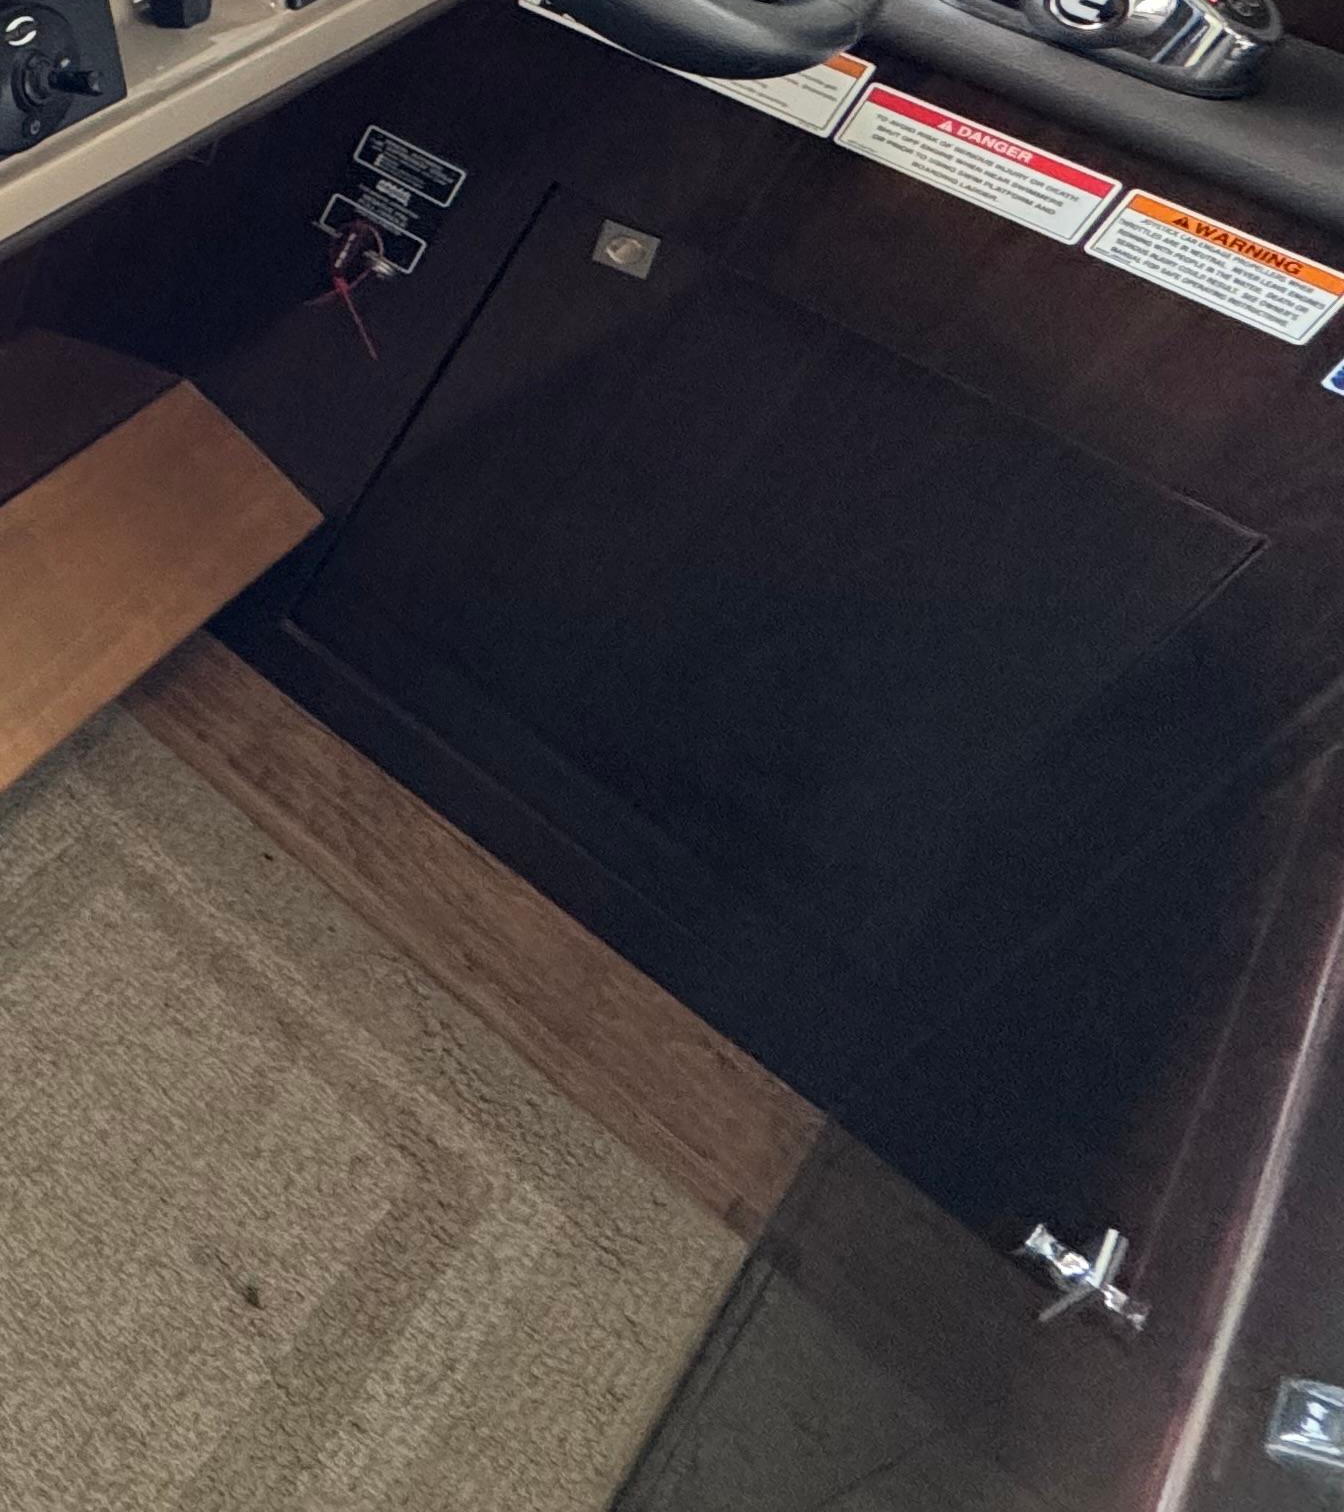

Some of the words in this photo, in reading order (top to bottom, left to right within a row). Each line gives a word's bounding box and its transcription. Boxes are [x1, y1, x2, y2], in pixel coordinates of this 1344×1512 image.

[955, 124, 1035, 164] DANGER
[981, 180, 1035, 207] PLATFORM
[1032, 201, 1057, 216] AND
[1190, 221, 1307, 275] WARNING
